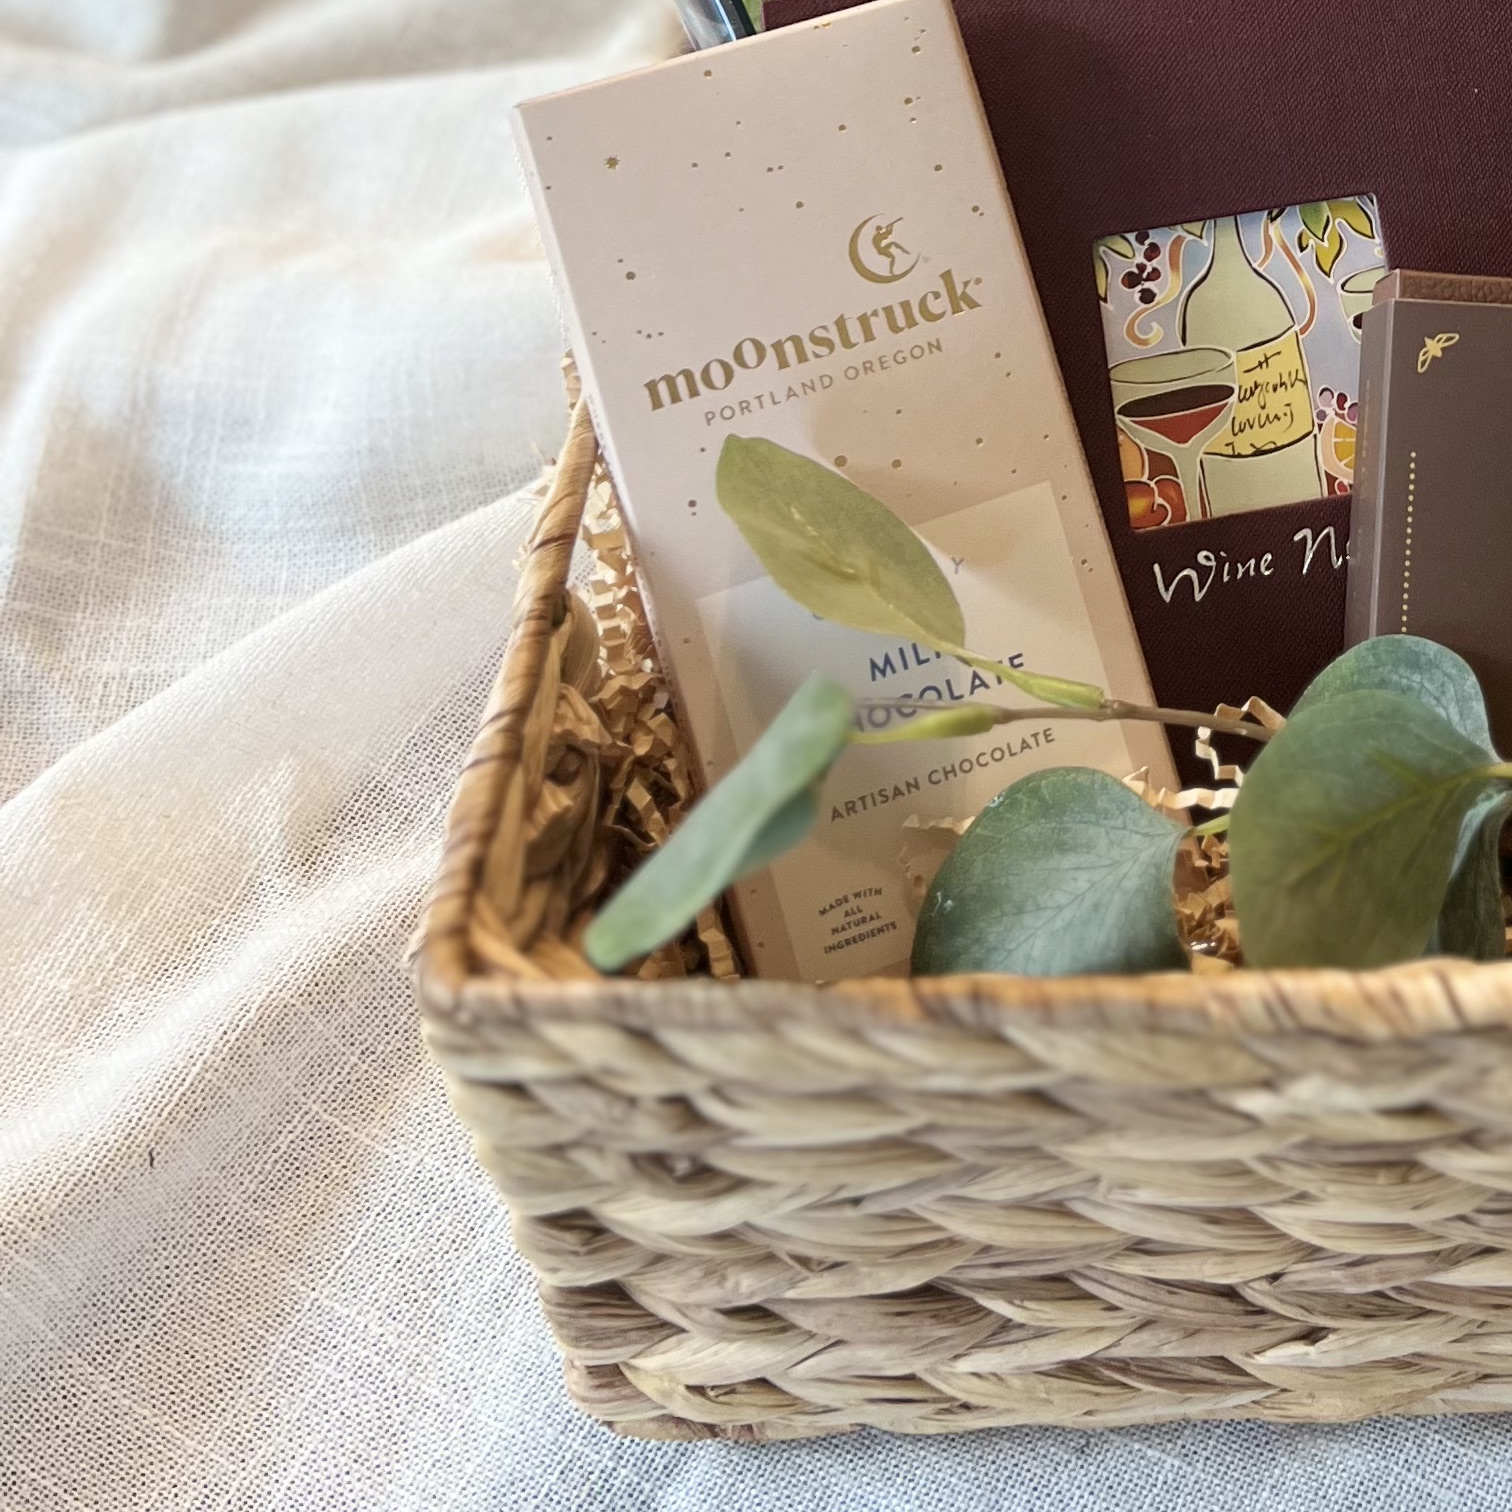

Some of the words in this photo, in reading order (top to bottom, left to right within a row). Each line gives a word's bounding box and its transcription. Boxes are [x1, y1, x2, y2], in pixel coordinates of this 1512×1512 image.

[704, 374, 834, 426] PORTLAND
[843, 338, 943, 381] OREGON
[1153, 550, 1275, 604] Wine
[830, 776, 921, 823] ARTISAN
[927, 727, 1056, 786] CHOCOLATE
[818, 893, 850, 917] MADE
[852, 887, 883, 901] WITH
[844, 905, 863, 918] ALL
[823, 920, 897, 955] INGREDIENTS
[831, 911, 882, 936] NATURAL
